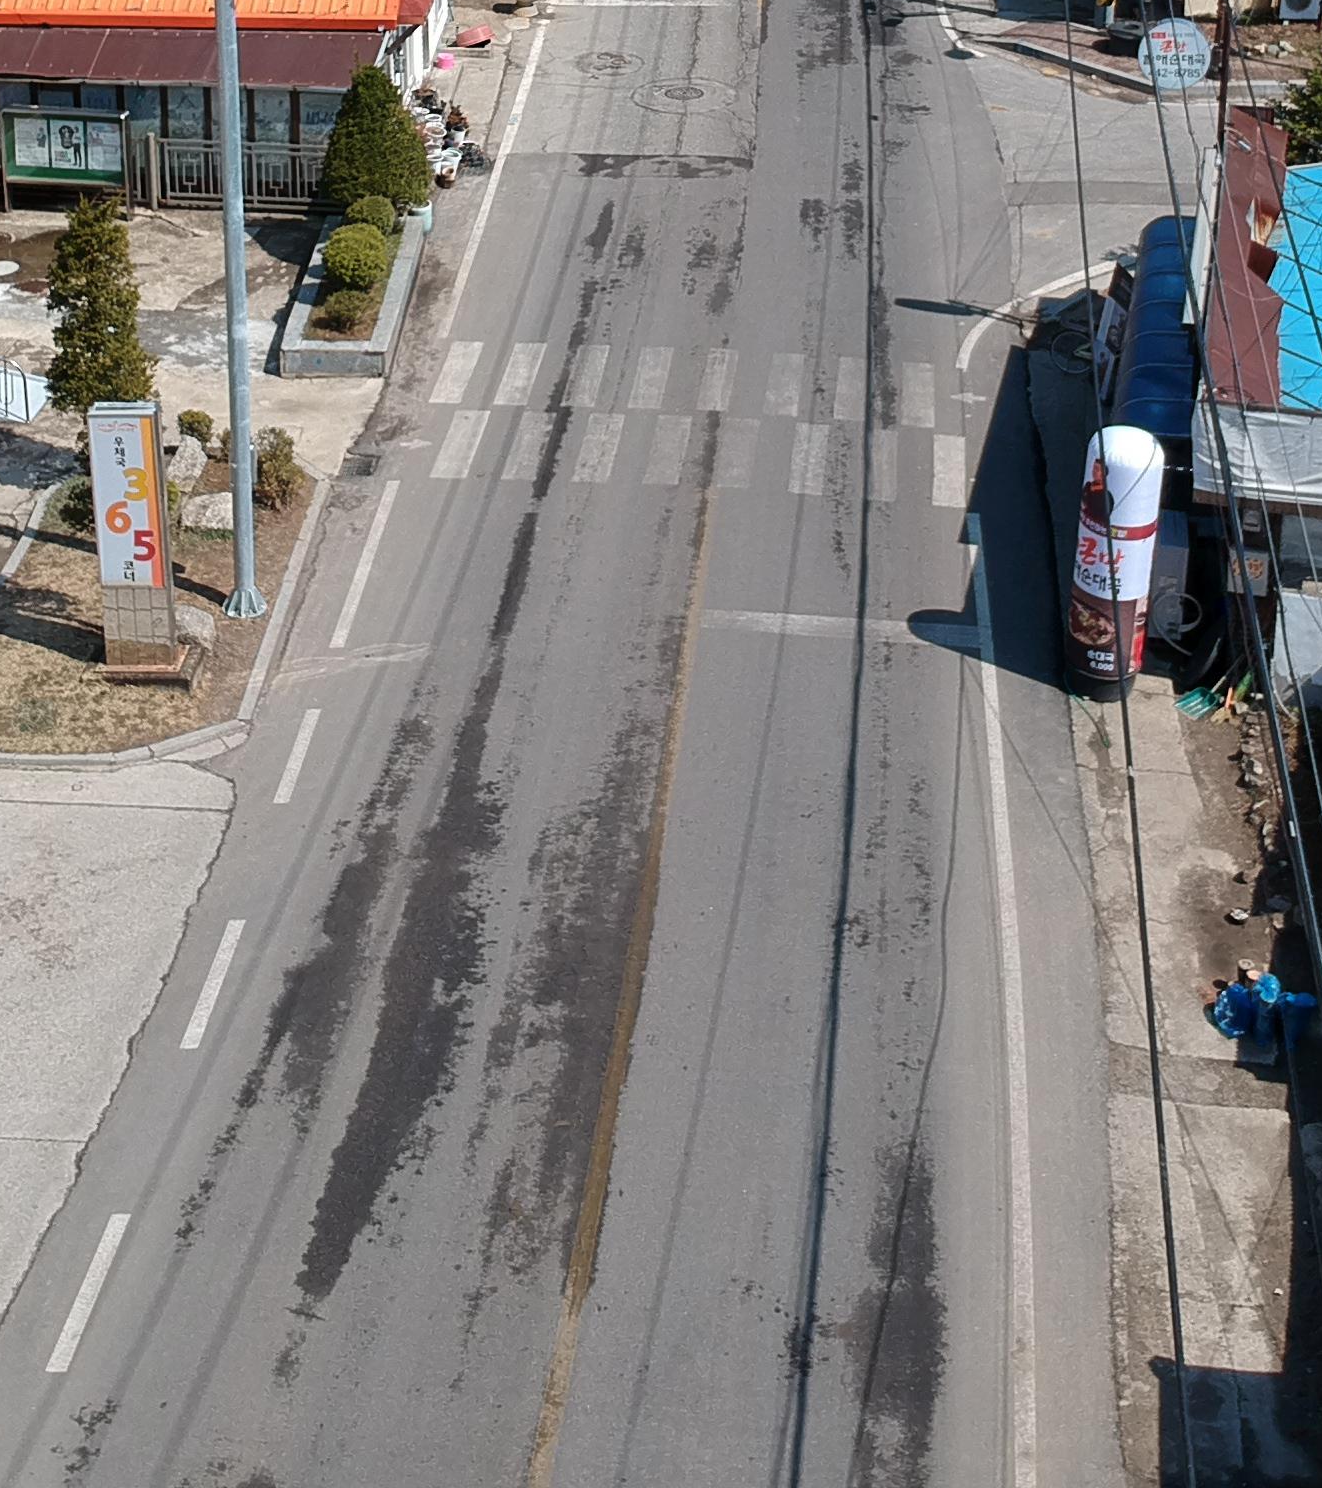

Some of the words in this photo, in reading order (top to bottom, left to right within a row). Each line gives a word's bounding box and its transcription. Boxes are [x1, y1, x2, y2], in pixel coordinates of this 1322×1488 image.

[113, 436, 126, 467] 우체국
[105, 467, 157, 562] 365
[123, 560, 136, 582] 코너
